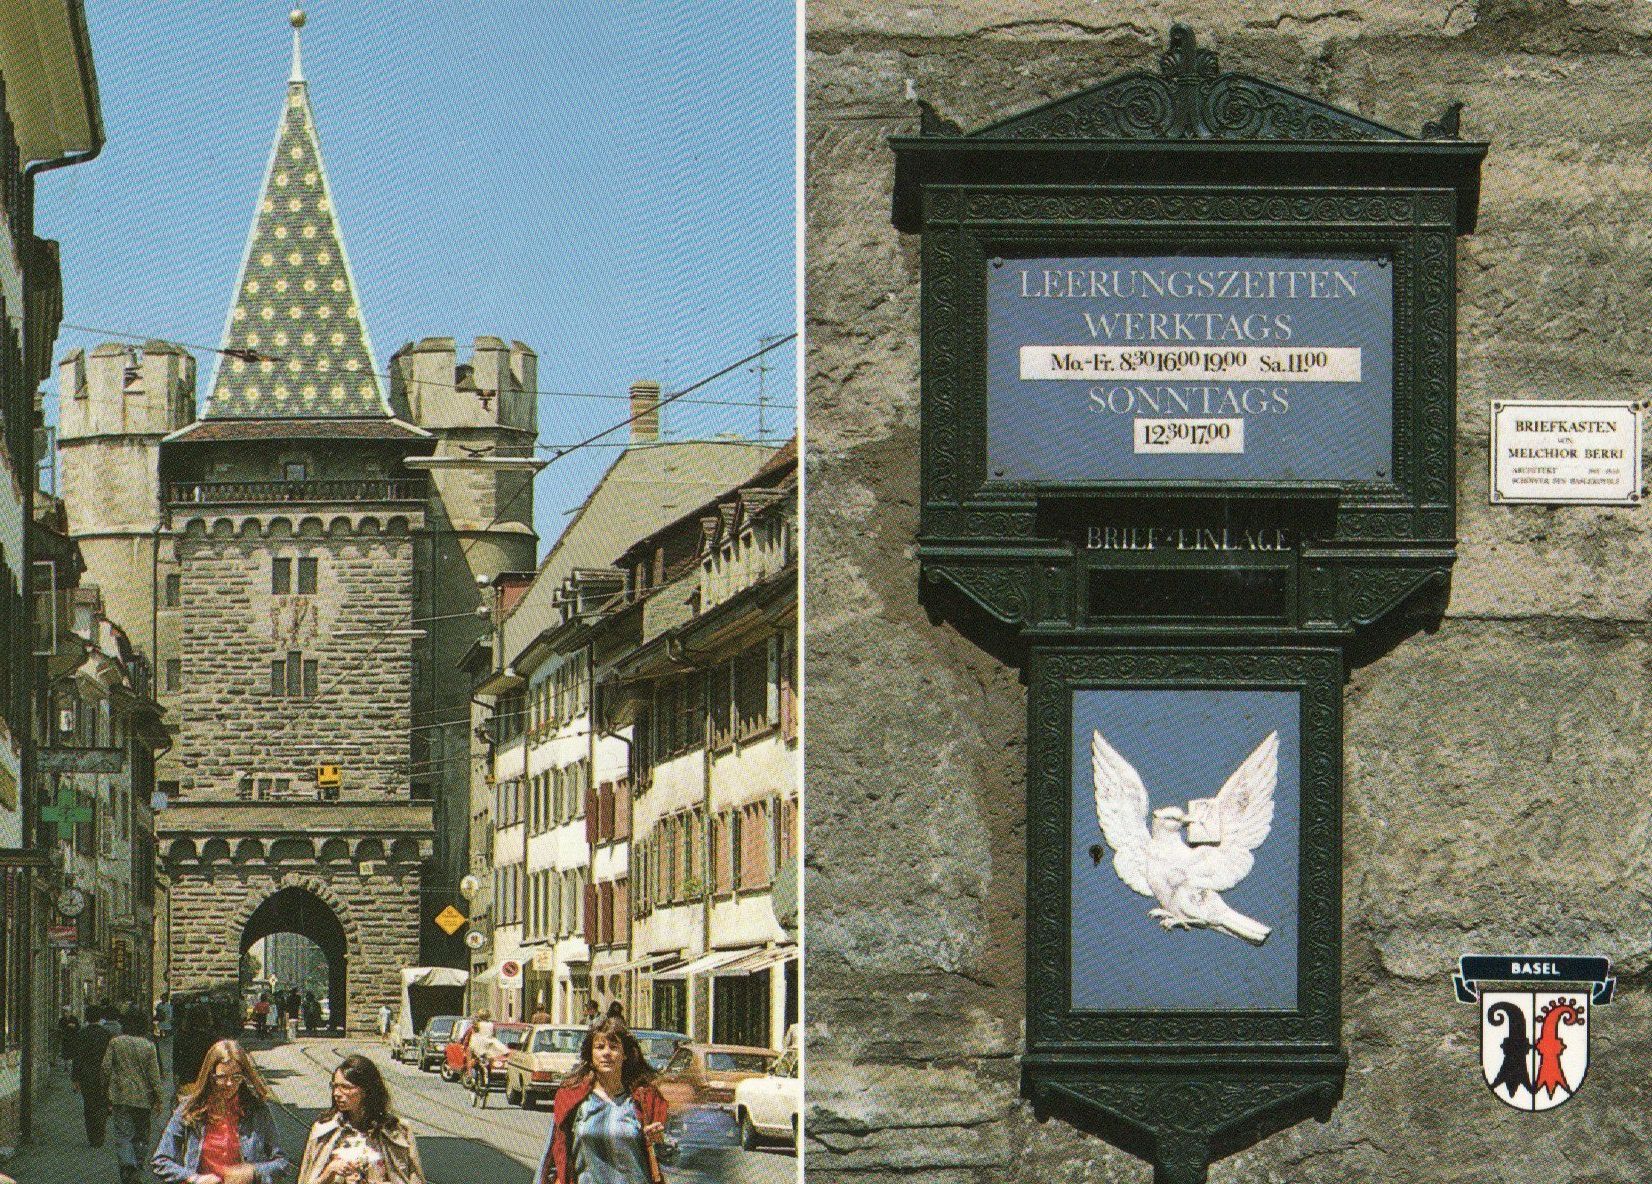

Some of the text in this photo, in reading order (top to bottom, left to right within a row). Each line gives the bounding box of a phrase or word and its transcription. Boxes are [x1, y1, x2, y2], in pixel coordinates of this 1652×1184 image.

[1020, 270, 1360, 299] LEERUNGSZEITEN
[1082, 312, 1293, 341] WERKTAGS
[1089, 386, 1290, 414] SONNTAGS
[1515, 420, 1617, 433] BRIEFKASTEN
[1508, 448, 1624, 460] MELCHIOR BERRI
